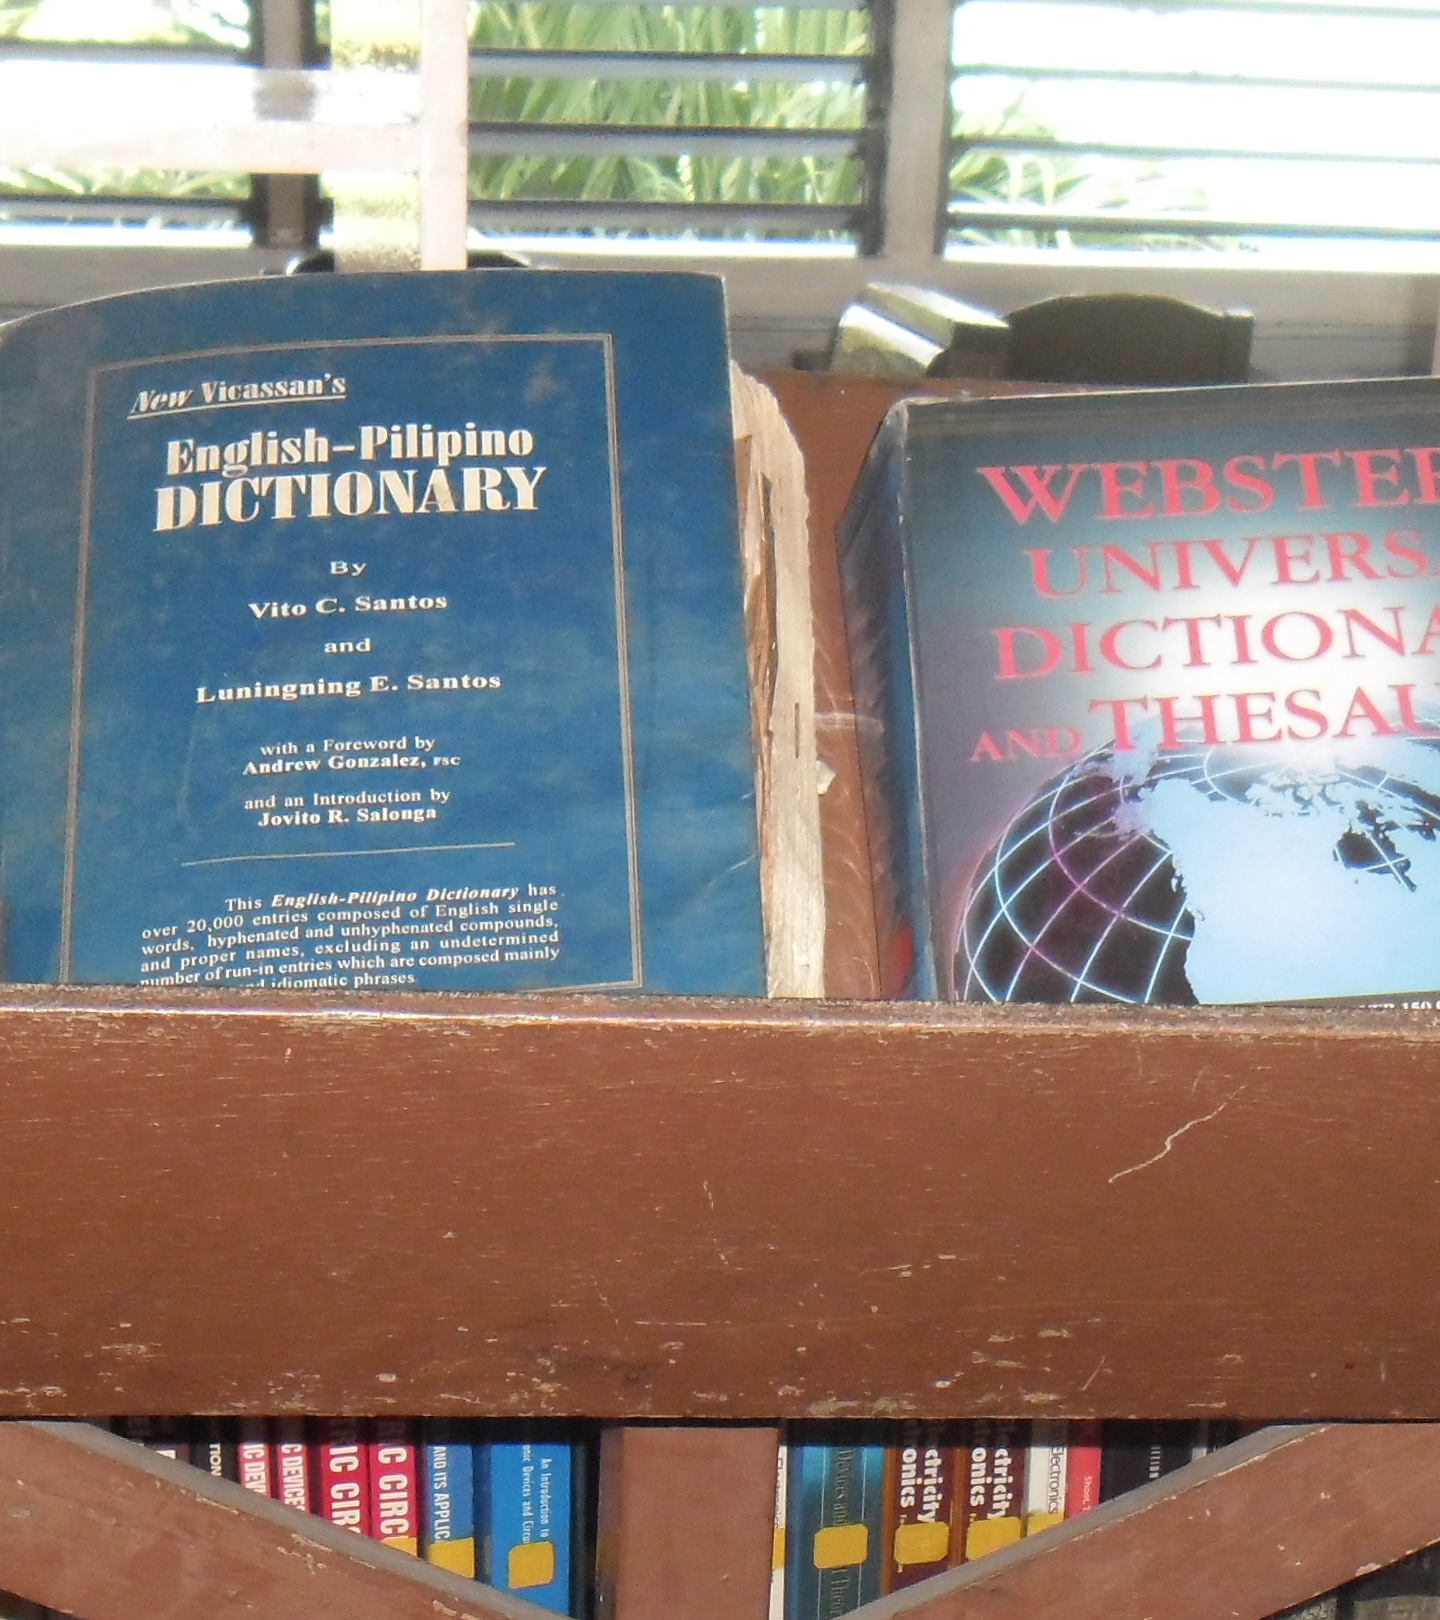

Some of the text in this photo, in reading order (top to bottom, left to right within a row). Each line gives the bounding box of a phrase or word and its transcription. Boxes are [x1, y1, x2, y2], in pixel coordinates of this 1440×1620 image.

[130, 373, 346, 415] New Vicassan's
[153, 466, 547, 533] DICTIONARY
[330, 561, 366, 576] By
[248, 594, 448, 620] Vito C. Santos
[324, 638, 371, 653] and
[196, 674, 501, 704] Luningning E. Santos
[260, 736, 436, 756] with a Foreword by
[969, 723, 1082, 763] AND
[242, 753, 461, 776] Andrew Gonzalez, FSC
[244, 788, 450, 810] and an Introduction by
[258, 807, 437, 828] Jovito R. Salonga
[225, 883, 556, 912] This English-Pilipino Dictionary has
[142, 899, 558, 939] over 20,000 entries composed of English single
[208, 926, 299, 950] hyphenated
[305, 924, 333, 939] and
[341, 919, 454, 939] unhyphenated
[460, 915, 558, 935] compounds,
[140, 930, 559, 973] and proper names, excluding an undetermined
[205, 966, 223, 981] of
[226, 962, 274, 979] run-in
[279, 957, 332, 975] entries
[338, 954, 385, 970] which
[390, 956, 415, 968] are
[419, 949, 500, 967] composed
[504, 946, 560, 962] mainly
[540, 1472, 552, 1525] Introduction
